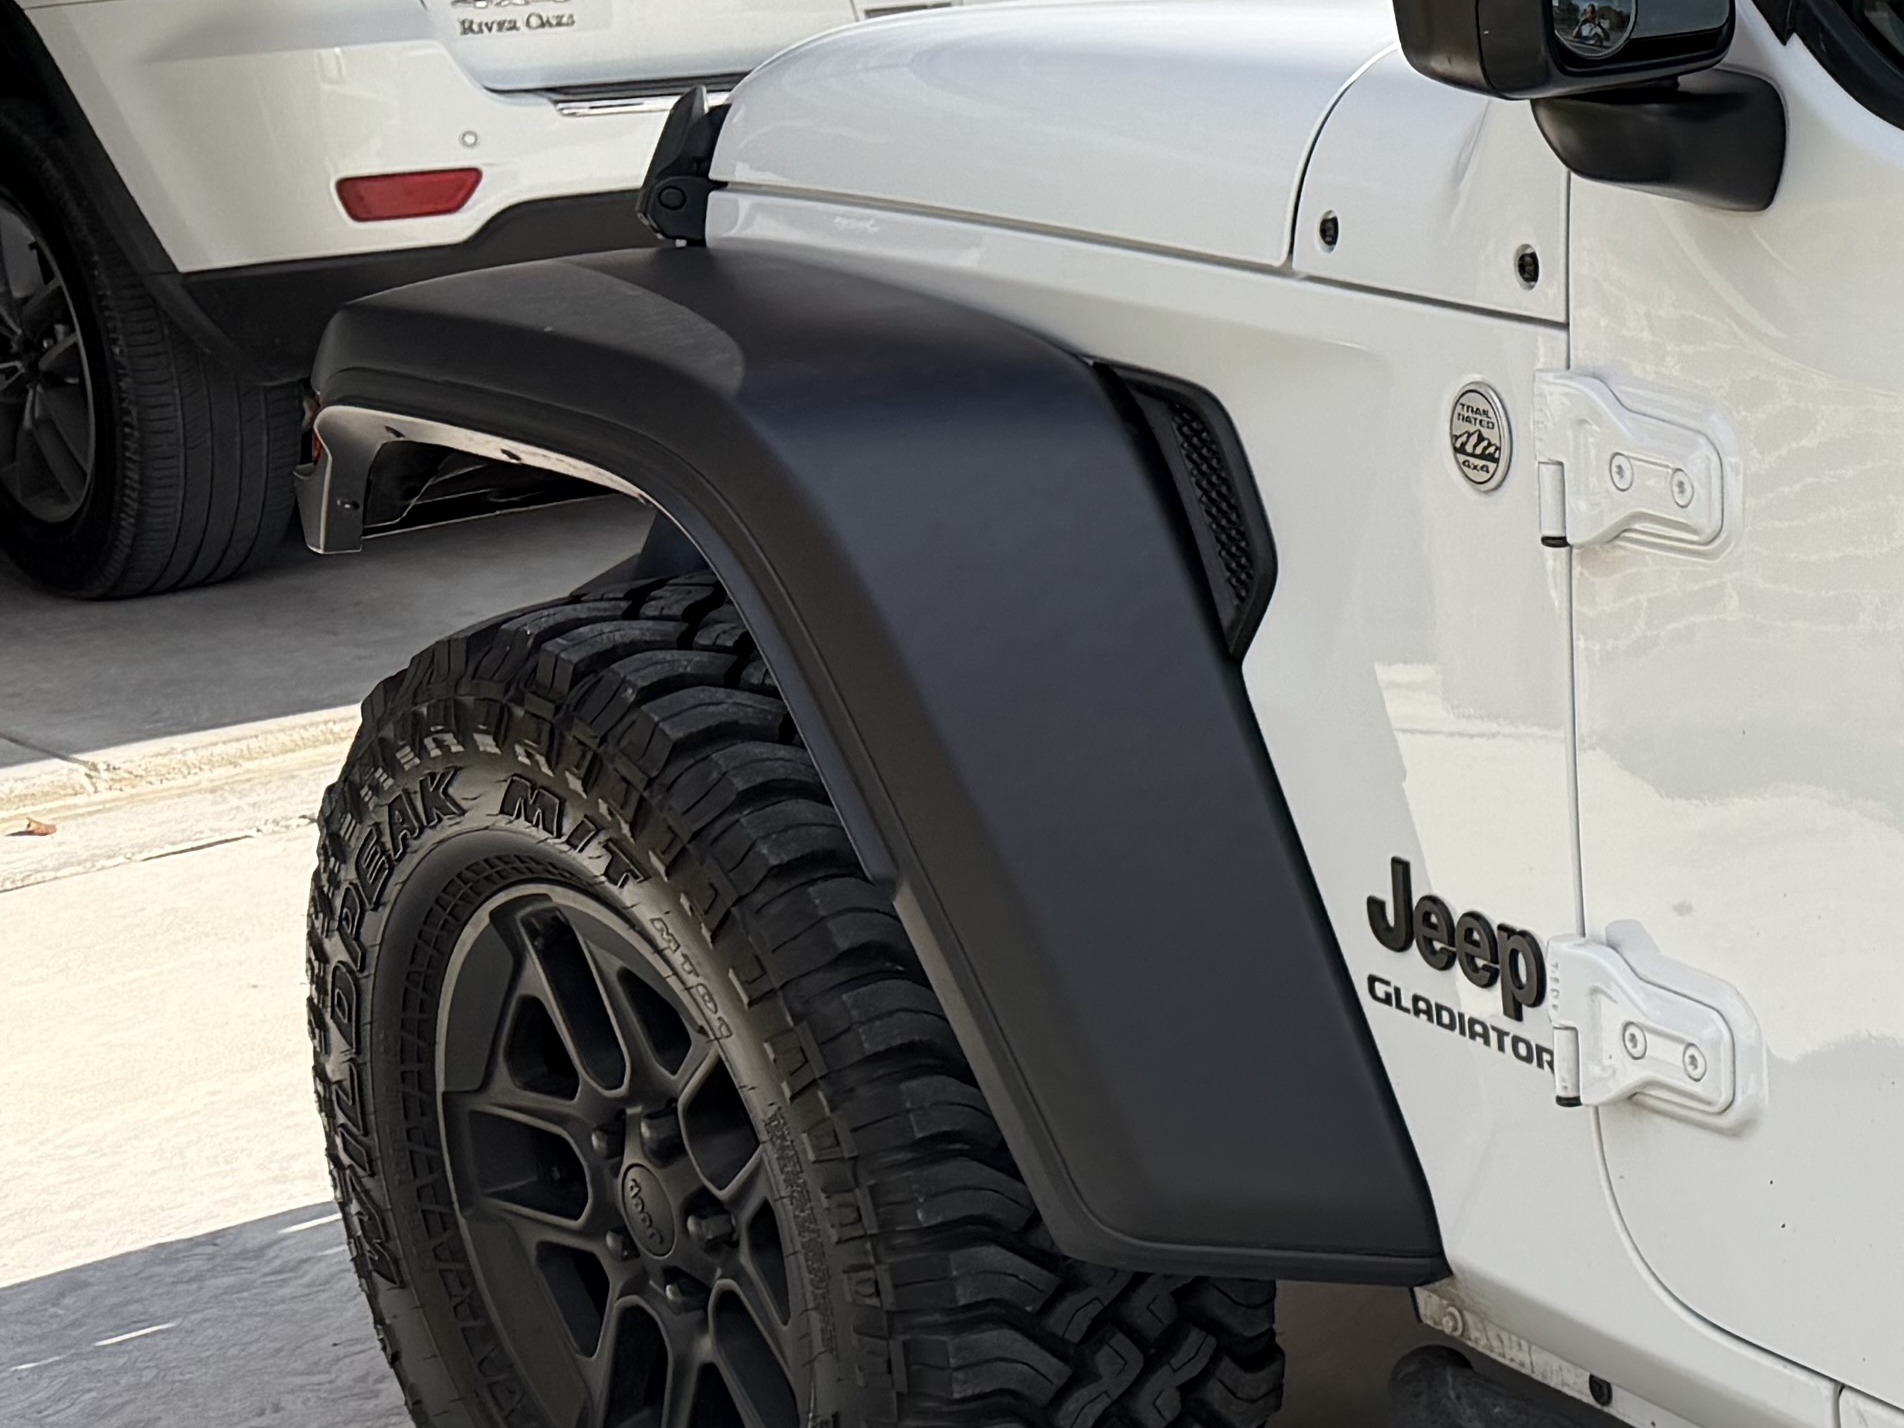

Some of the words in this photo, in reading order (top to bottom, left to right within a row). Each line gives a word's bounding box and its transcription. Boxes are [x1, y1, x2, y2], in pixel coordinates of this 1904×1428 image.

[1457, 412, 1496, 431] RATED
[1459, 402, 1493, 420] TRAIL
[1366, 855, 1548, 1023] Jeep
[330, 765, 467, 1290] WILDPEAK
[1366, 973, 1555, 1075] GLADIATOR
